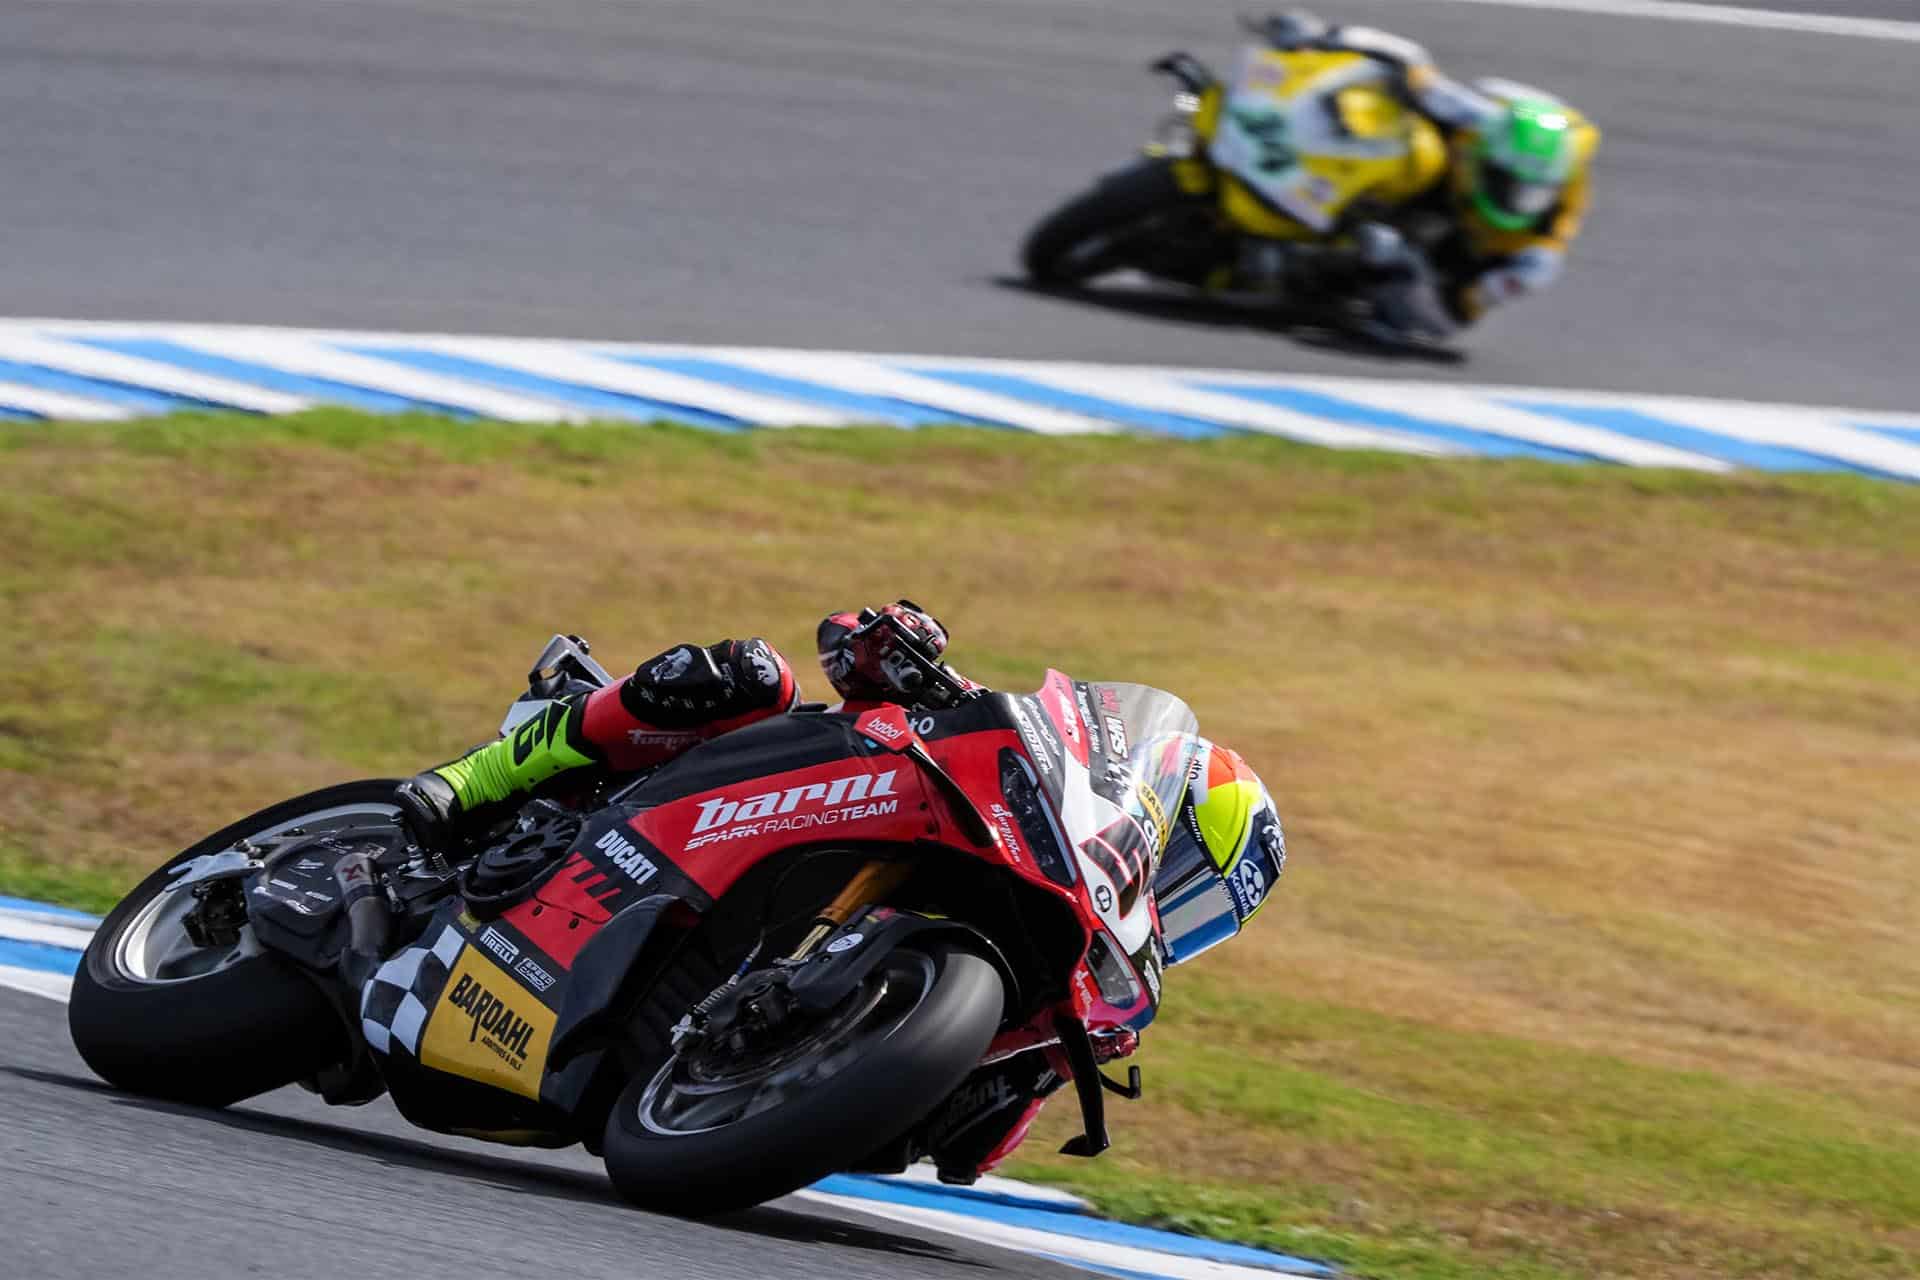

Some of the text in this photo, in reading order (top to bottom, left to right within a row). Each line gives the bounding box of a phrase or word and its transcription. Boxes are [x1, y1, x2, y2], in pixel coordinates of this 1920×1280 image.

[866, 715, 904, 739] babol
[692, 769, 899, 833] barni
[594, 828, 659, 886] DUCATI
[684, 822, 762, 850] SPARK
[479, 925, 520, 964] PIRELLI
[447, 973, 536, 1060] BARDAHL
